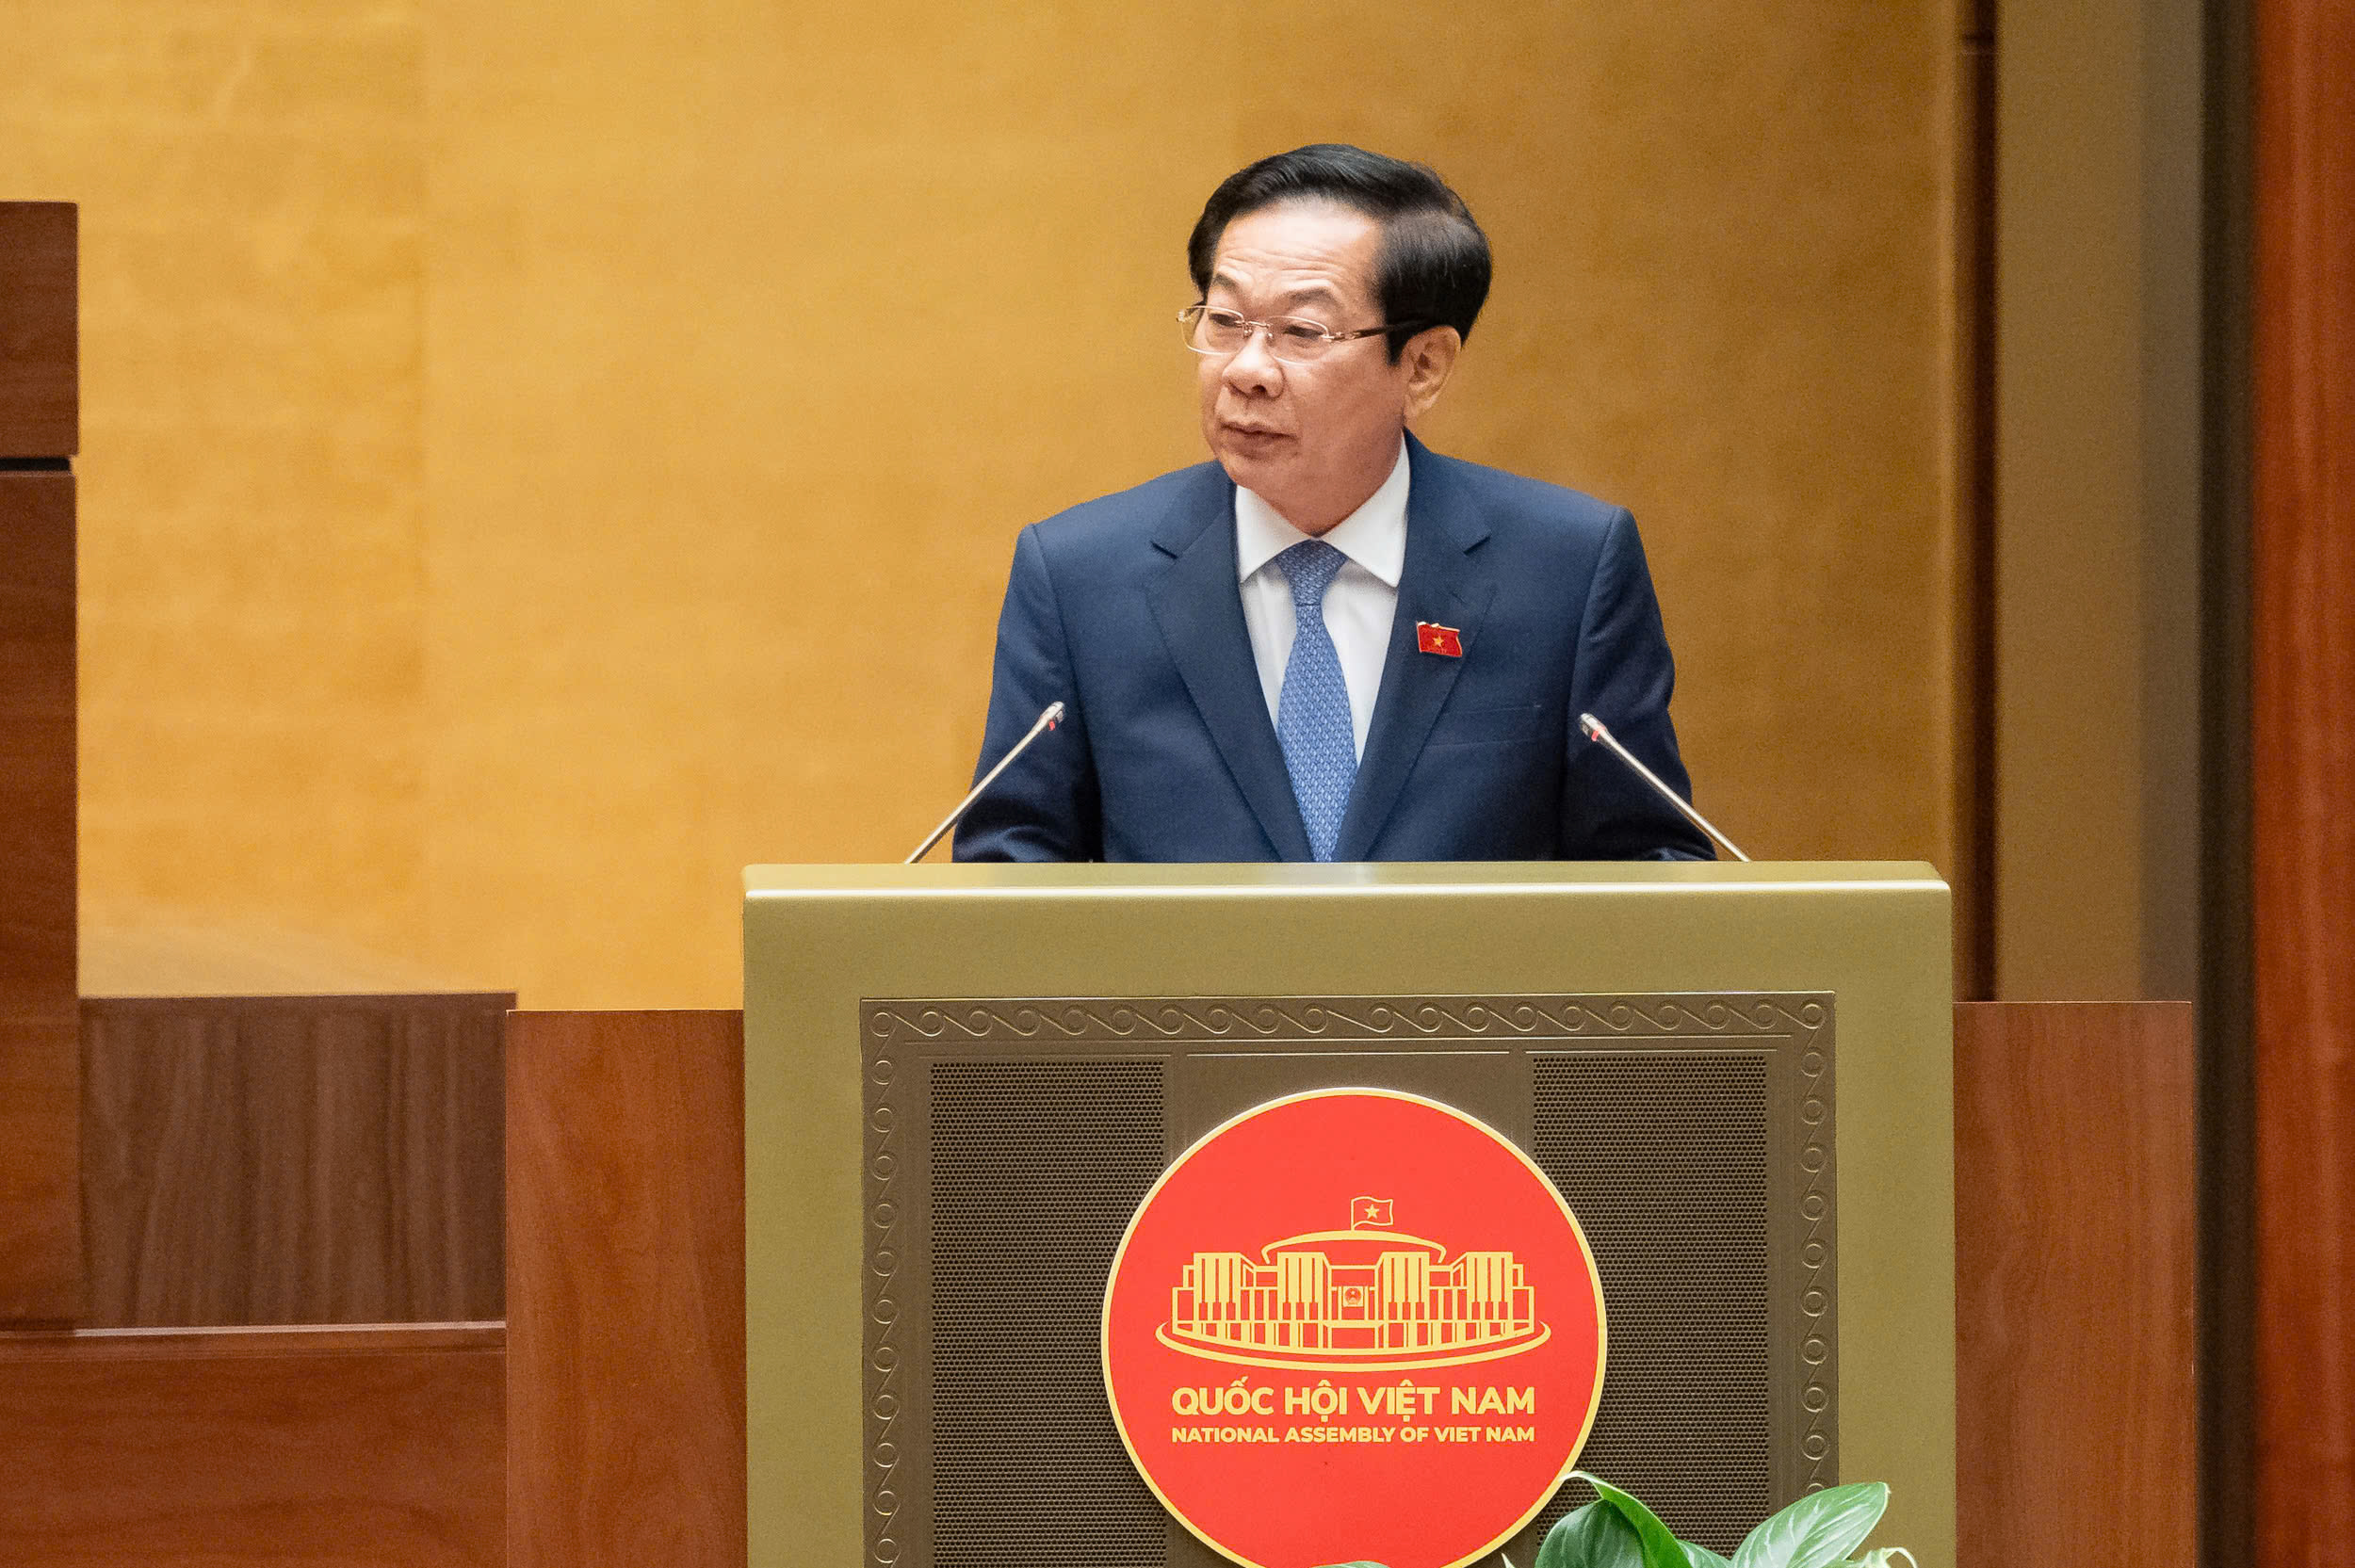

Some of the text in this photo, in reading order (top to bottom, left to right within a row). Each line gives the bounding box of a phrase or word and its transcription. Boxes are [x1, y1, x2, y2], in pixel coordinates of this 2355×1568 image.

[1171, 1376, 1535, 1423] QUỐC HỘI VIỆT NAM
[1172, 1427, 1535, 1443] NATIONAL ASSEMBLY OF VIET NAM
